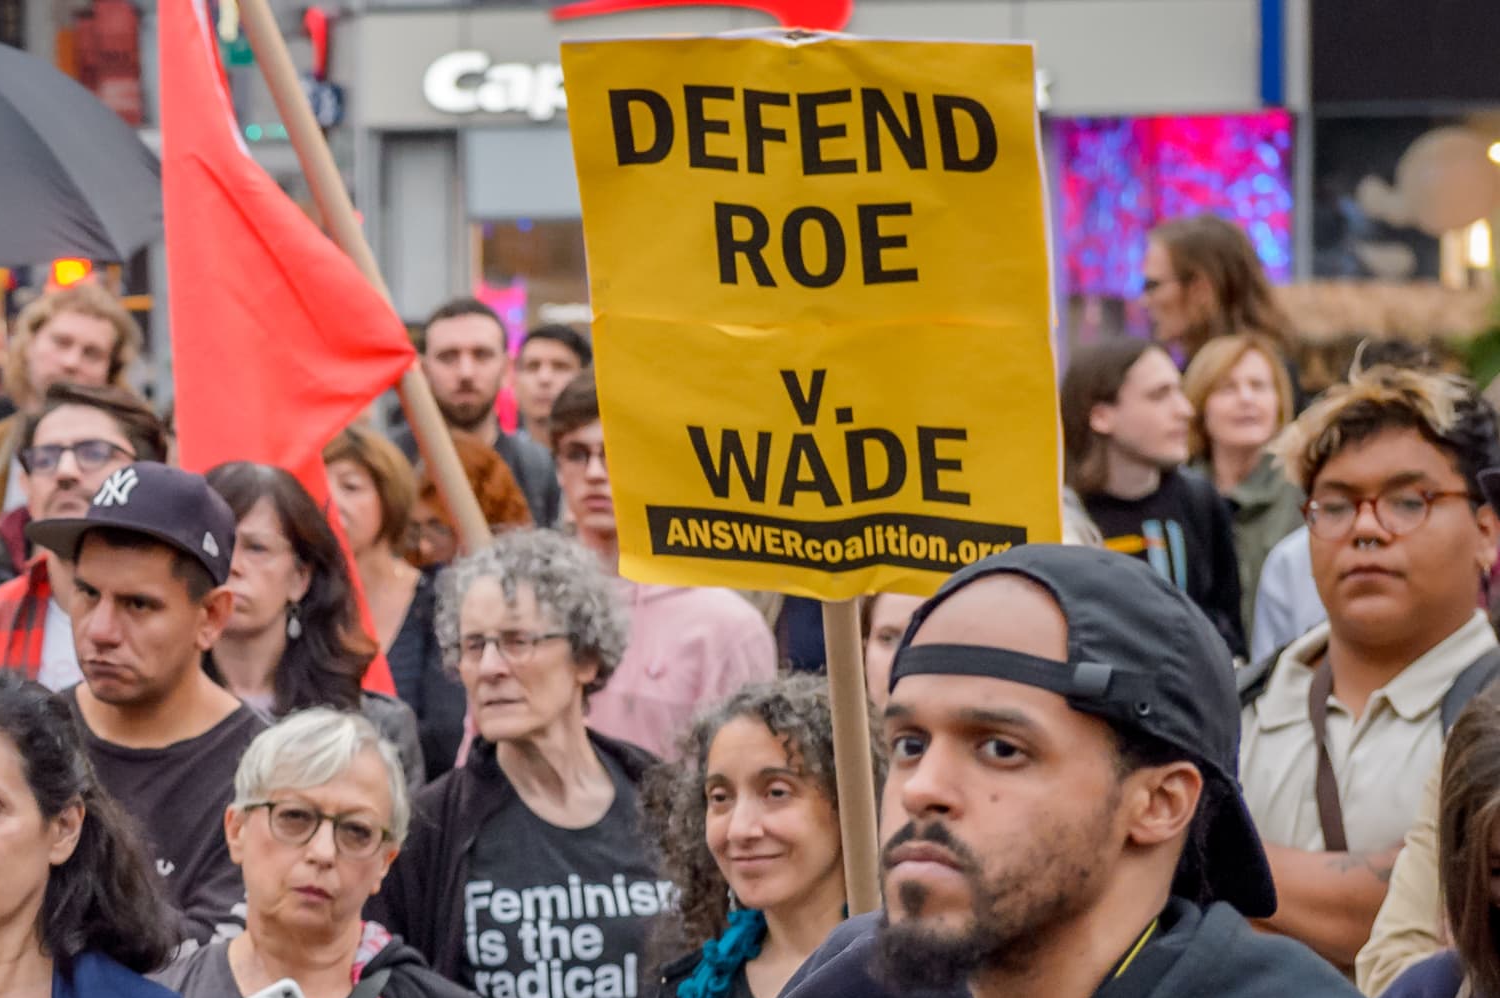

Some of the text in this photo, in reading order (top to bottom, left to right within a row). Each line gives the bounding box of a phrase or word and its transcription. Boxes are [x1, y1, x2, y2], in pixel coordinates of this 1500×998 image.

[608, 84, 998, 176] DEFEND
[713, 201, 918, 289] ROE
[687, 424, 971, 508] WADE
[517, 917, 605, 964] the
